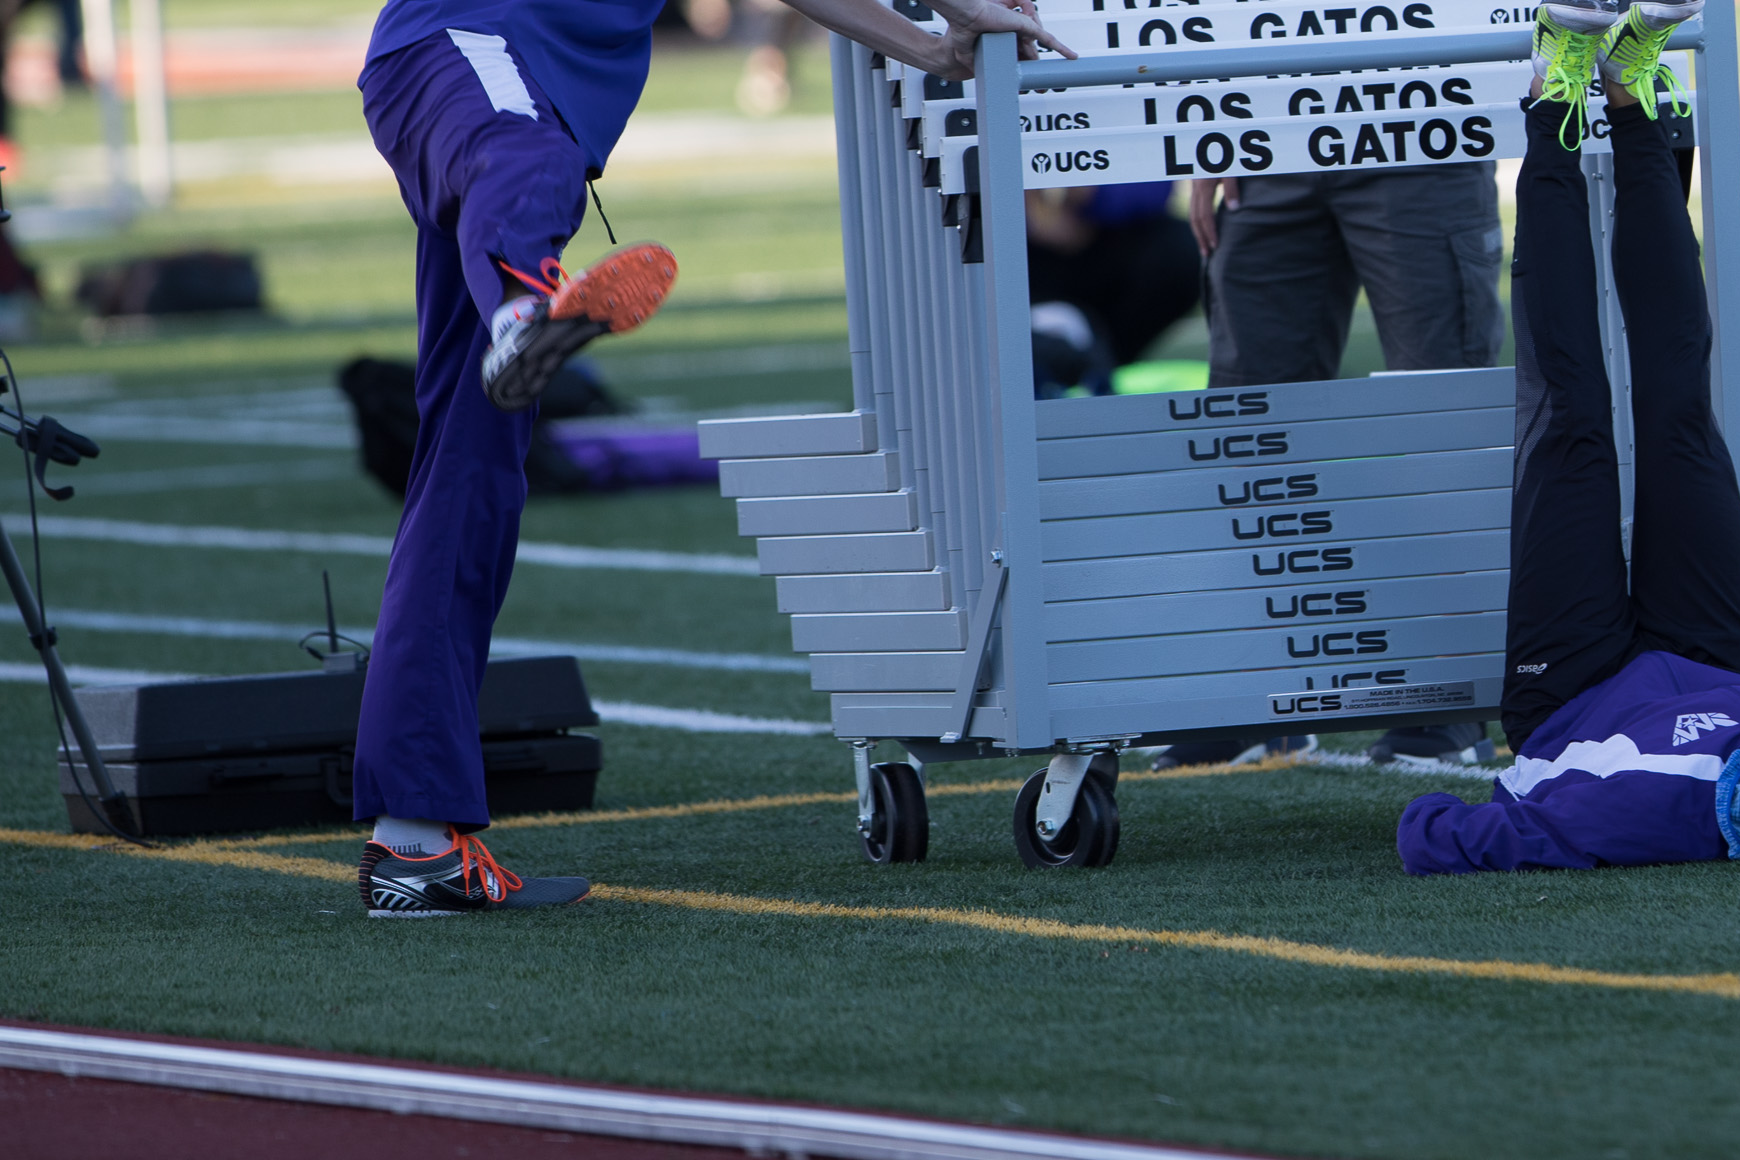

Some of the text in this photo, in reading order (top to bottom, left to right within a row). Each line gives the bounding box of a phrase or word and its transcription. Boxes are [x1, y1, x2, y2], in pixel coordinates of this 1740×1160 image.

[1250, 3, 1435, 39] GATOS
[1036, 113, 1090, 131] UCS
[1288, 78, 1474, 116] GATOS
[1055, 116, 1496, 176] UCS LOS GATOS
[1169, 392, 1269, 420] UCS
[1188, 432, 1289, 461] UCS
[1218, 474, 1319, 505] UCS
[1232, 511, 1332, 540] UCS
[1253, 548, 1353, 576] UCS
[1266, 591, 1367, 618] UCS
[1287, 630, 1388, 658] UCS
[1273, 695, 1341, 714] UCS
